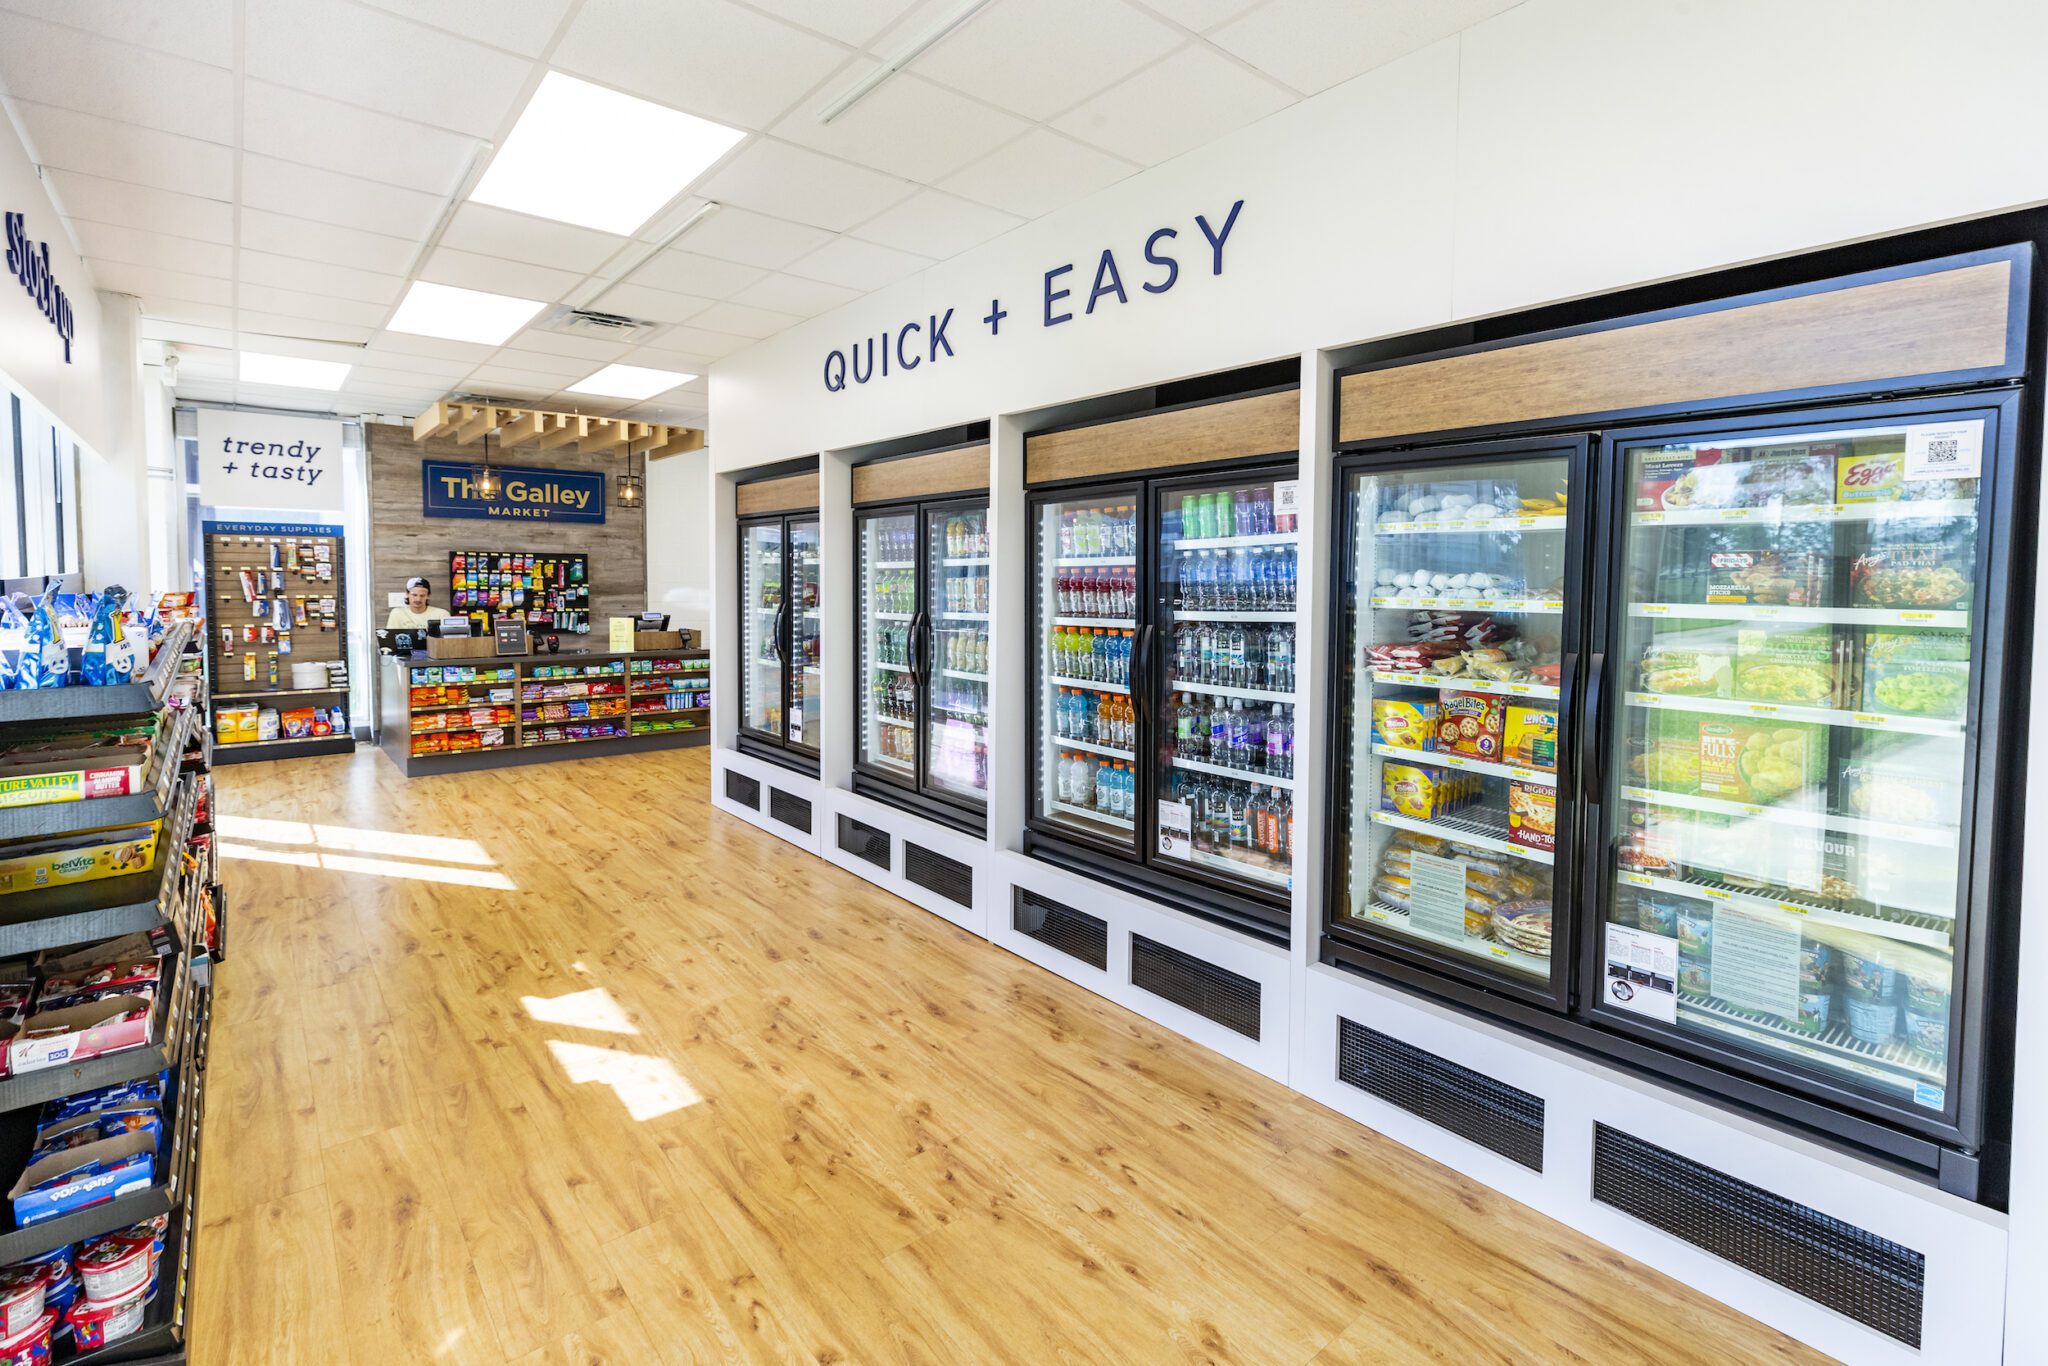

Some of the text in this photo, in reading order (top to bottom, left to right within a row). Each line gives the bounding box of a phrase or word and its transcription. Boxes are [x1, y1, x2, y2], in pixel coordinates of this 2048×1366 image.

[824, 199, 1244, 392] QUICK + EASY
[223, 437, 321, 463] trendy
[223, 461, 323, 486] + tasty
[1843, 463, 1896, 486] Eggo
[505, 481, 591, 509] Galley
[488, 506, 551, 518] MARKET
[216, 523, 332, 534] EVERYDAY SUPPLIES
[1890, 549, 1937, 560] THAI
[1443, 696, 1486, 711] Bagel Bites
[1483, 739, 1490, 748] 9
[1701, 742, 1736, 759] FULLS
[30, 775, 76, 788] VALLEY
[51, 855, 96, 871] belVita
[49, 1050, 66, 1060] 100
